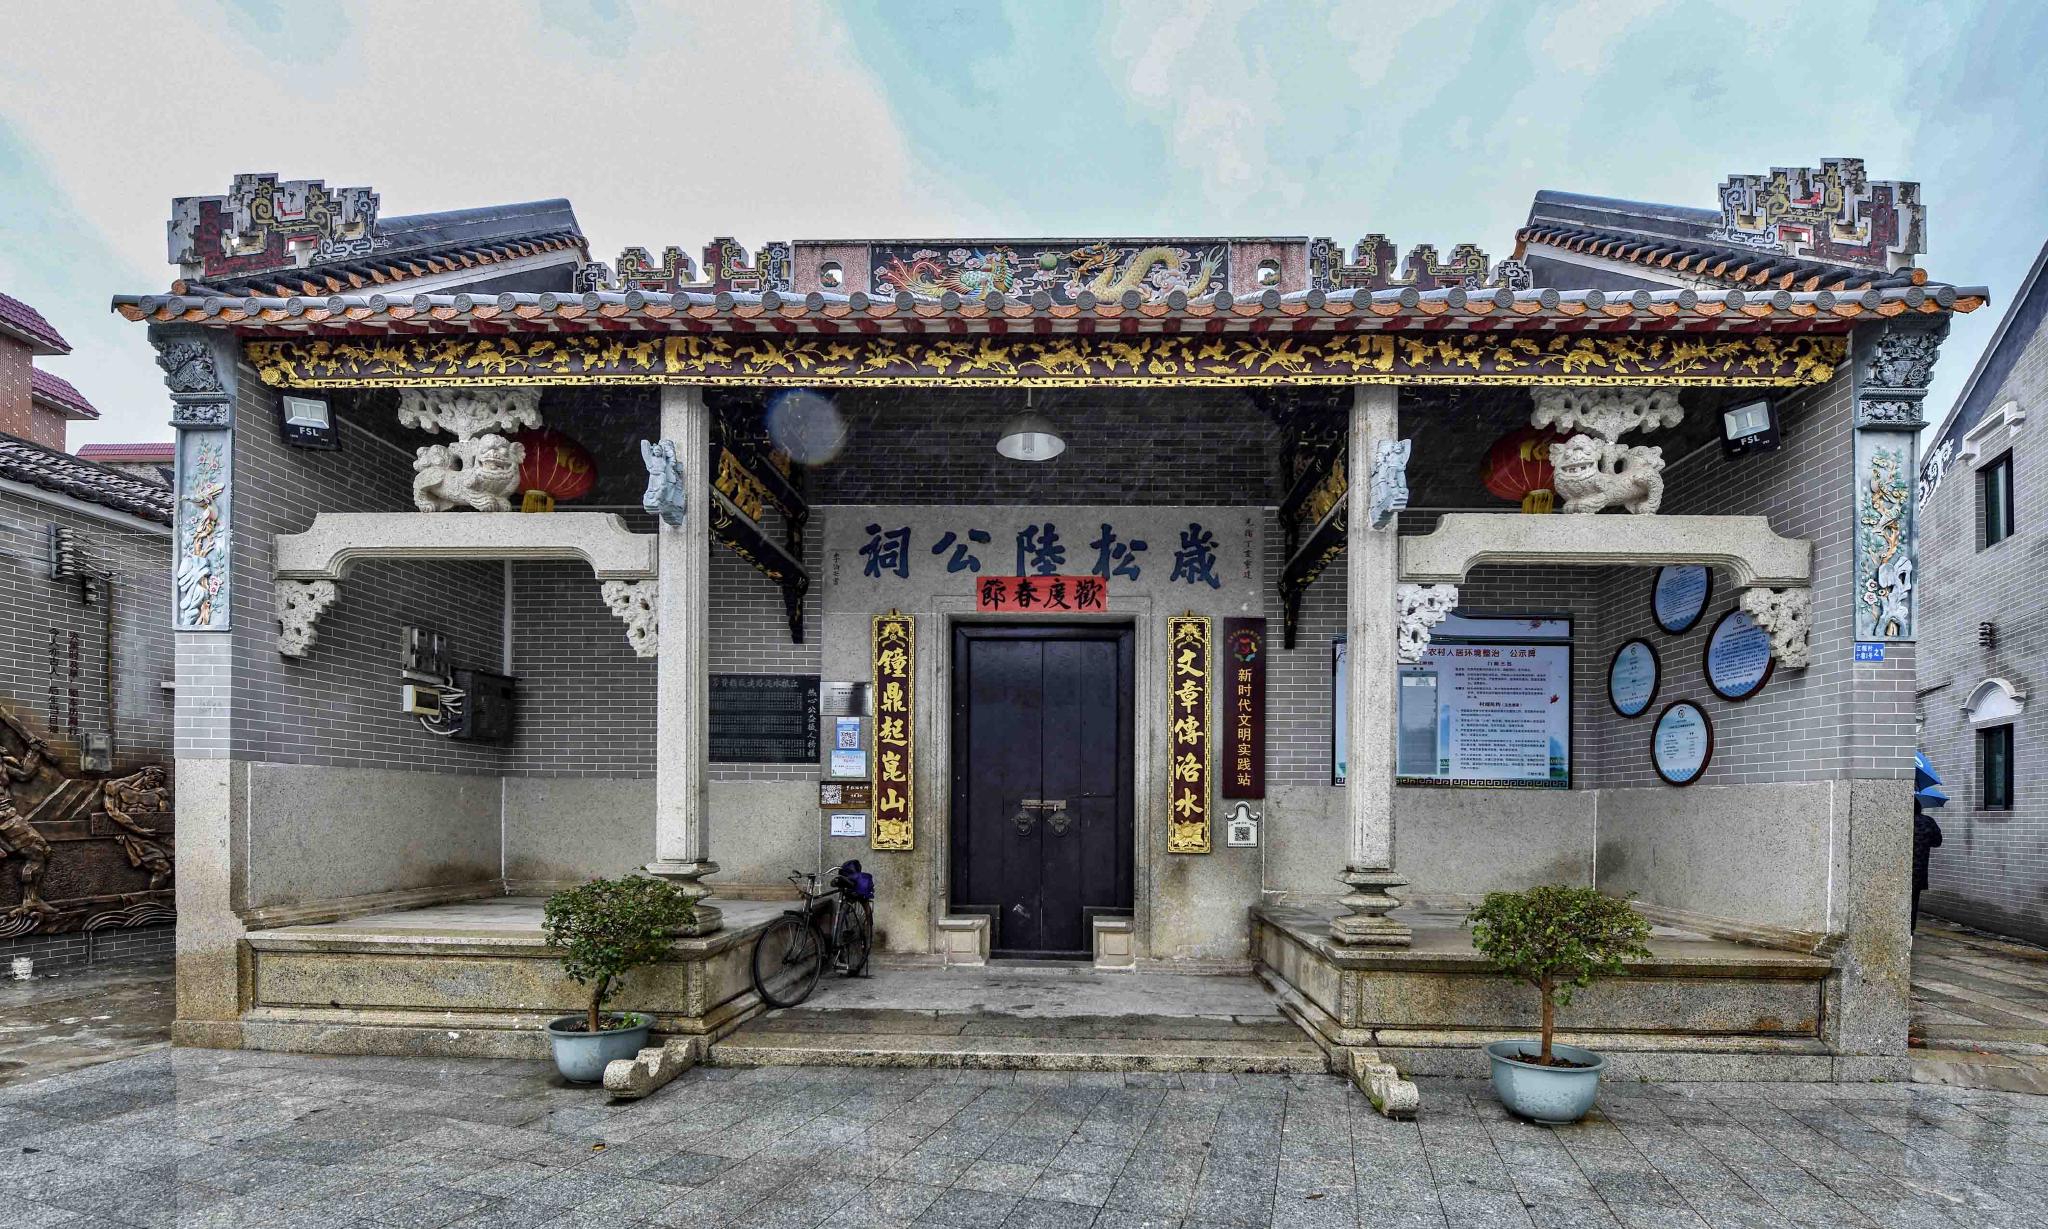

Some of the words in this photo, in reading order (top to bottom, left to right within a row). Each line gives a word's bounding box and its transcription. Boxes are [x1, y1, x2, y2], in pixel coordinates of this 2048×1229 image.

[299, 426, 319, 437] FSL
[1740, 434, 1760, 446] FSL
[1237, 668, 1253, 787] 新时代文明实践站
